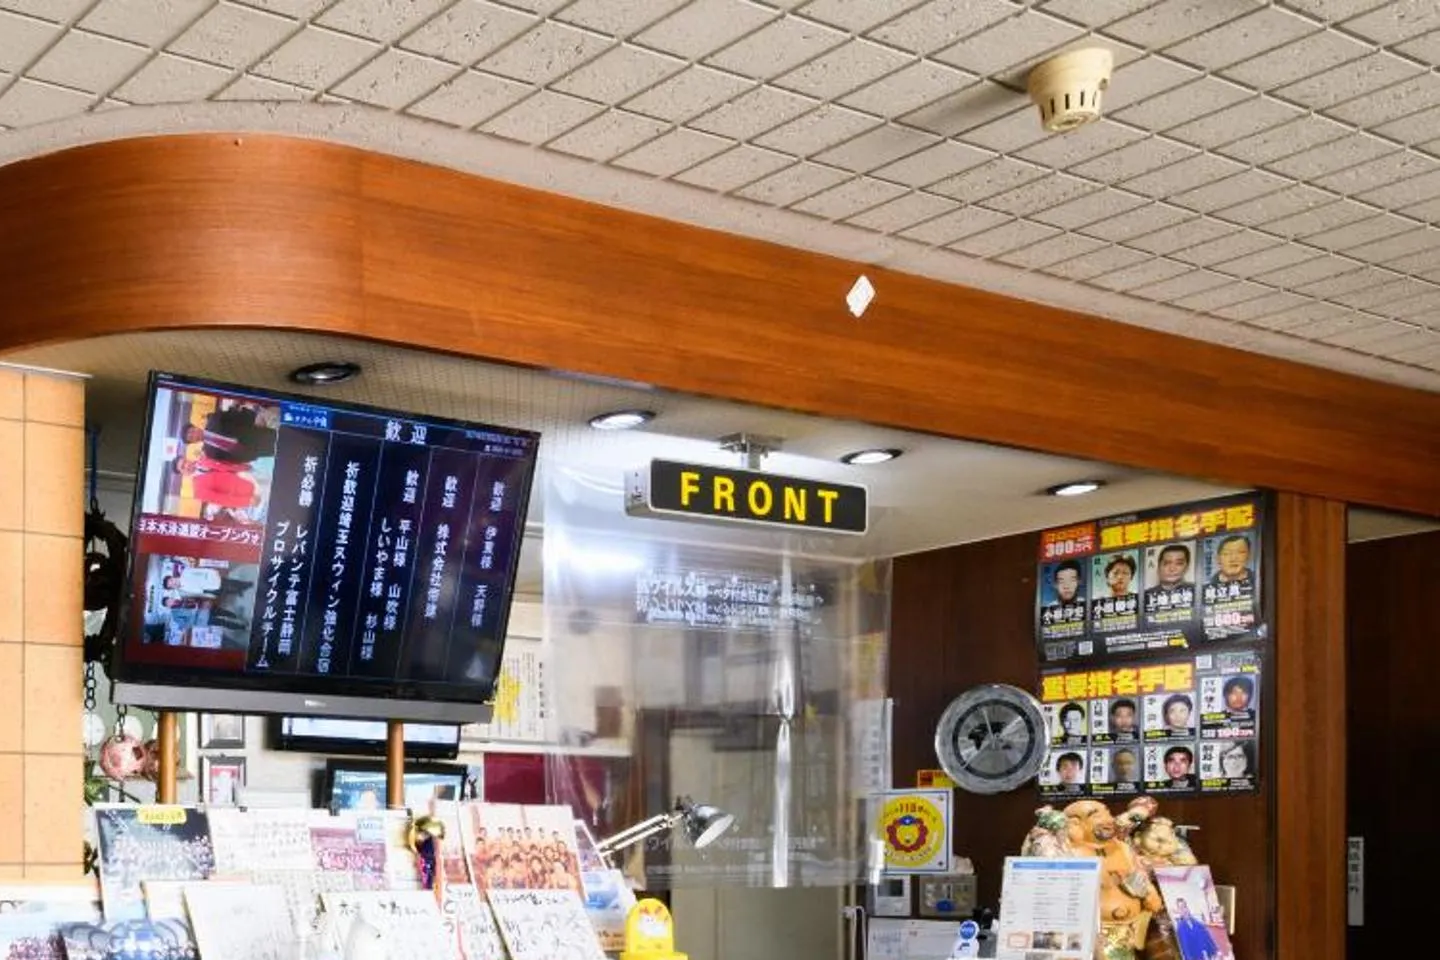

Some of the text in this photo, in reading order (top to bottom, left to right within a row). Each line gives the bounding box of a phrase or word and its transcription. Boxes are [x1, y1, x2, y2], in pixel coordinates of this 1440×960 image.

[385, 420, 428, 445] 歓迎
[403, 469, 420, 504] 歓迎
[441, 475, 458, 509] 歓迎
[679, 471, 839, 524] FRONT
[1042, 663, 1193, 701] 重要指名手配
